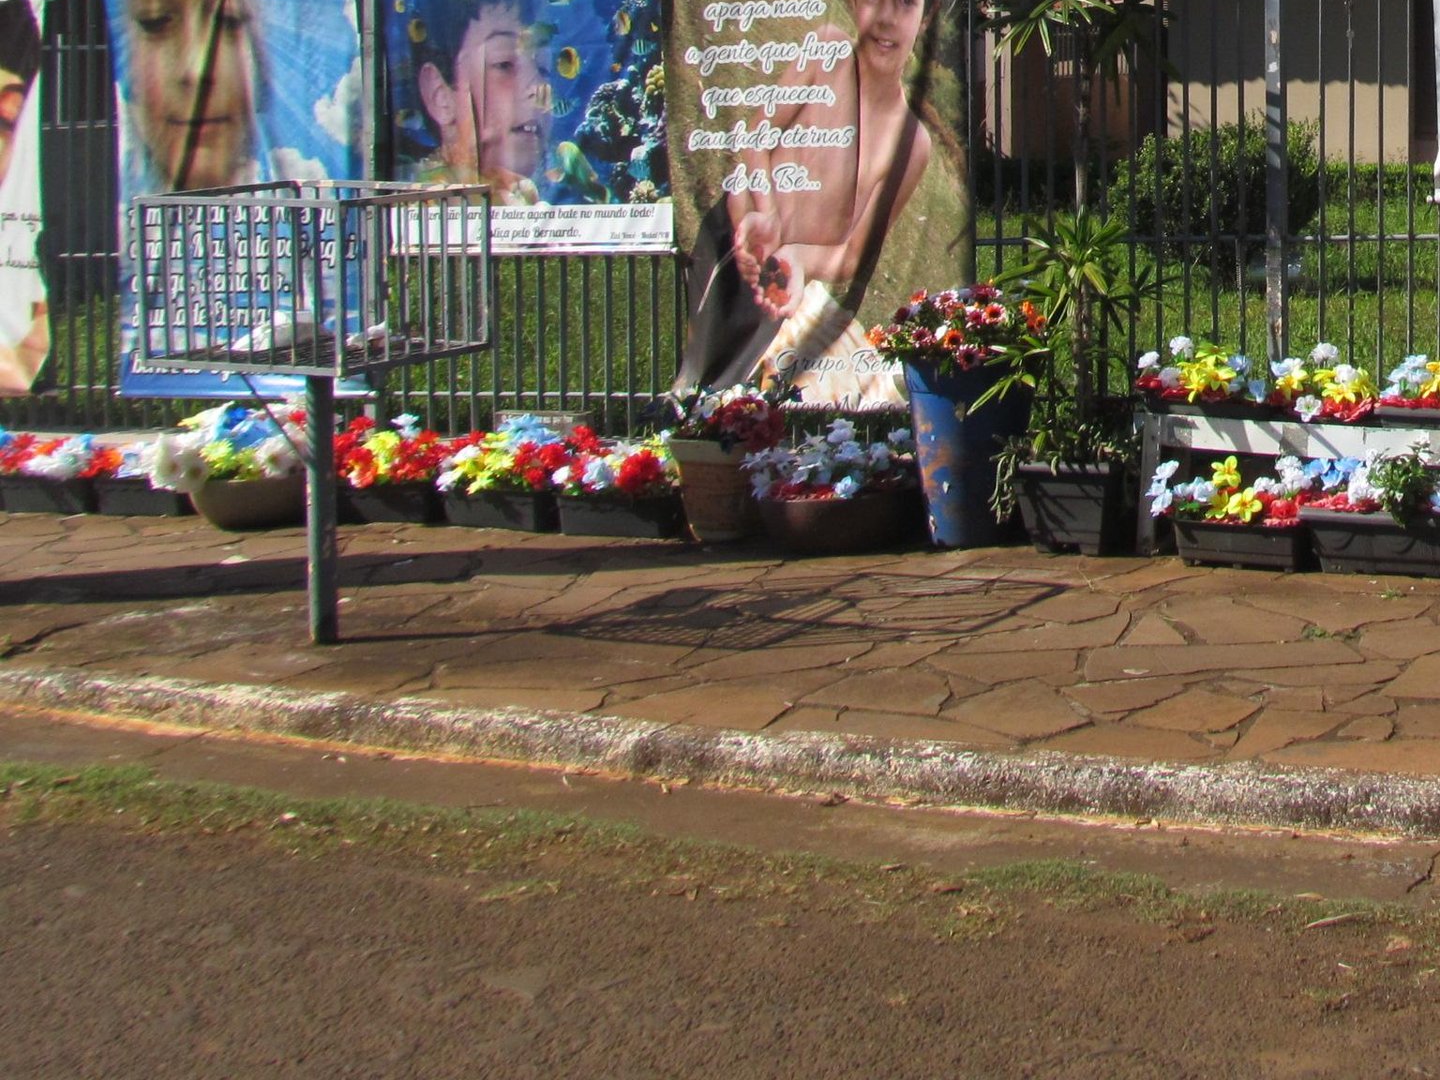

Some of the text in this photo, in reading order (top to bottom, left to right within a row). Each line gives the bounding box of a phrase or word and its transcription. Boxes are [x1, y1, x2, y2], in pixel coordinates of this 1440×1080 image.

[705, 3, 769, 30] apaga
[687, 33, 850, 75] a gente que finge
[704, 85, 835, 117] que esqueceu,
[690, 122, 854, 151] saudades eternas
[724, 164, 746, 193] de
[750, 169, 770, 193] ti,
[527, 210, 555, 222] agora
[580, 210, 593, 219] no
[594, 208, 628, 219] mundo
[511, 228, 530, 241] pelo
[533, 226, 582, 238] Bernardo.
[776, 349, 845, 384] Grupo
